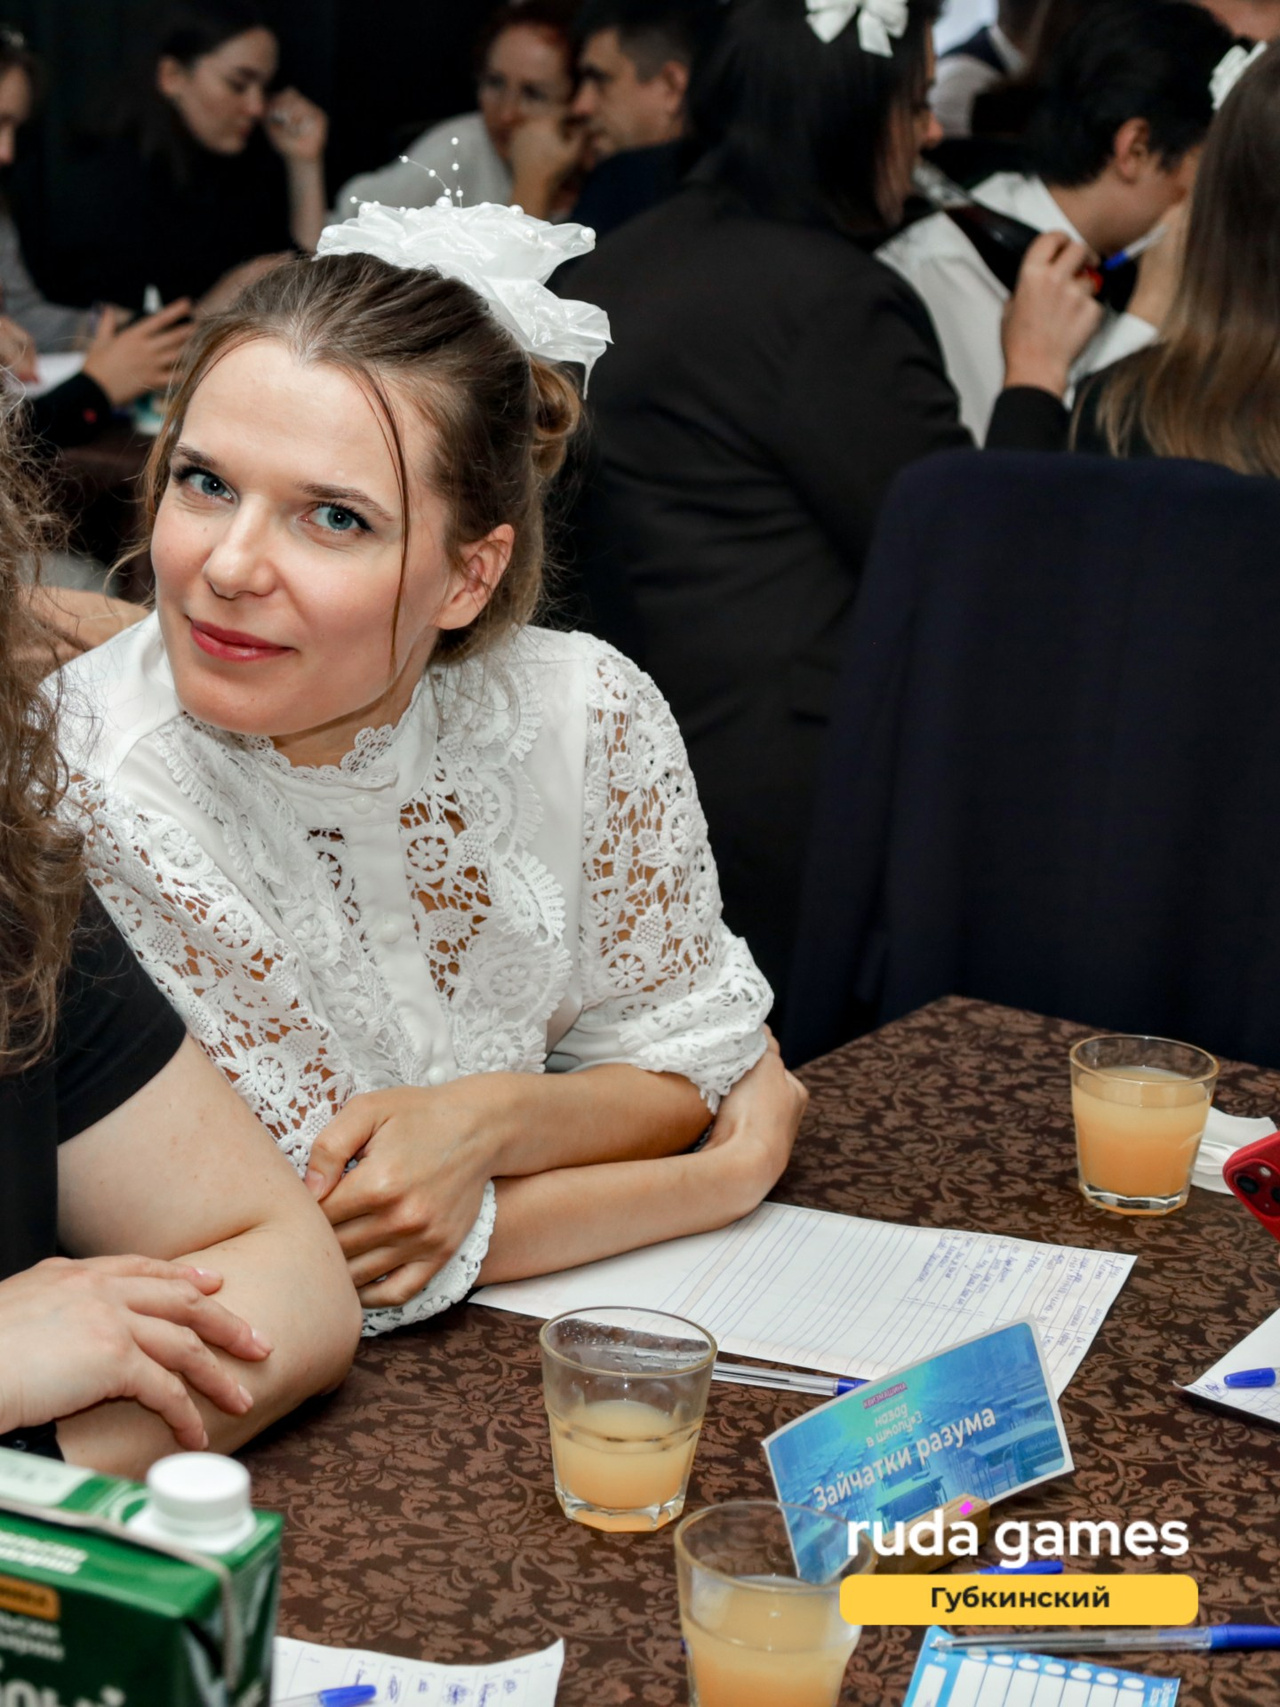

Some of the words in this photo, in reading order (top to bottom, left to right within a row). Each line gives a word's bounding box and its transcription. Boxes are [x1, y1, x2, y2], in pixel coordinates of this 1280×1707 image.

[874, 1403, 908, 1427] назад
[813, 1447, 912, 1511] Зайчатки
[916, 1407, 996, 1466] разума
